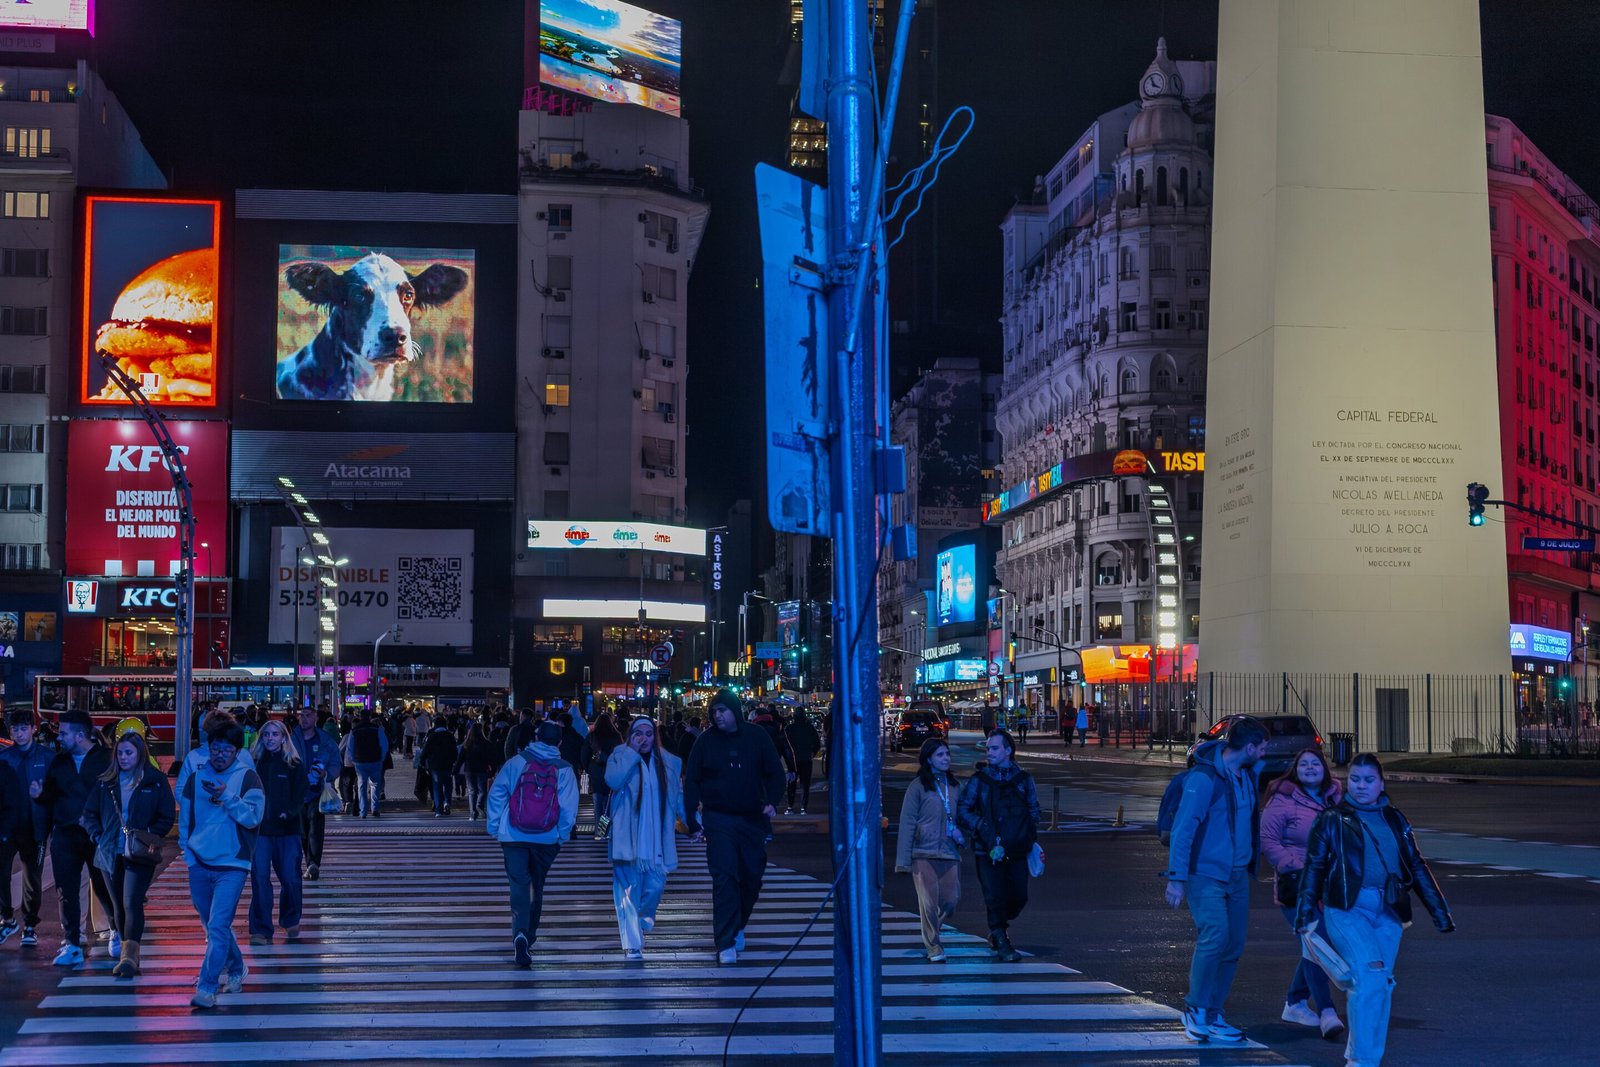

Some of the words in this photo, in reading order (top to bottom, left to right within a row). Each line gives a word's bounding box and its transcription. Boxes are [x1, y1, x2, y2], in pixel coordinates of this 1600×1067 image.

[1336, 410, 1382, 422] CAPITAL
[1388, 411, 1438, 423] FEDERAL
[105, 445, 189, 472] KFC
[324, 462, 411, 478] Atacama
[116, 487, 178, 506] DISFRUTÁ
[1332, 490, 1378, 500] NICOLAS
[1384, 490, 1443, 500] AVELLANEDA
[105, 509, 117, 522] EL
[120, 509, 154, 522] MEJOR
[156, 509, 181, 522] POLL
[117, 525, 136, 538] DEL
[138, 525, 176, 538] MUNDO
[1349, 523, 1380, 534] JULIO
[1398, 524, 1429, 534] ROCA
[713, 534, 722, 590] ASTROS
[121, 588, 177, 606] KFC
